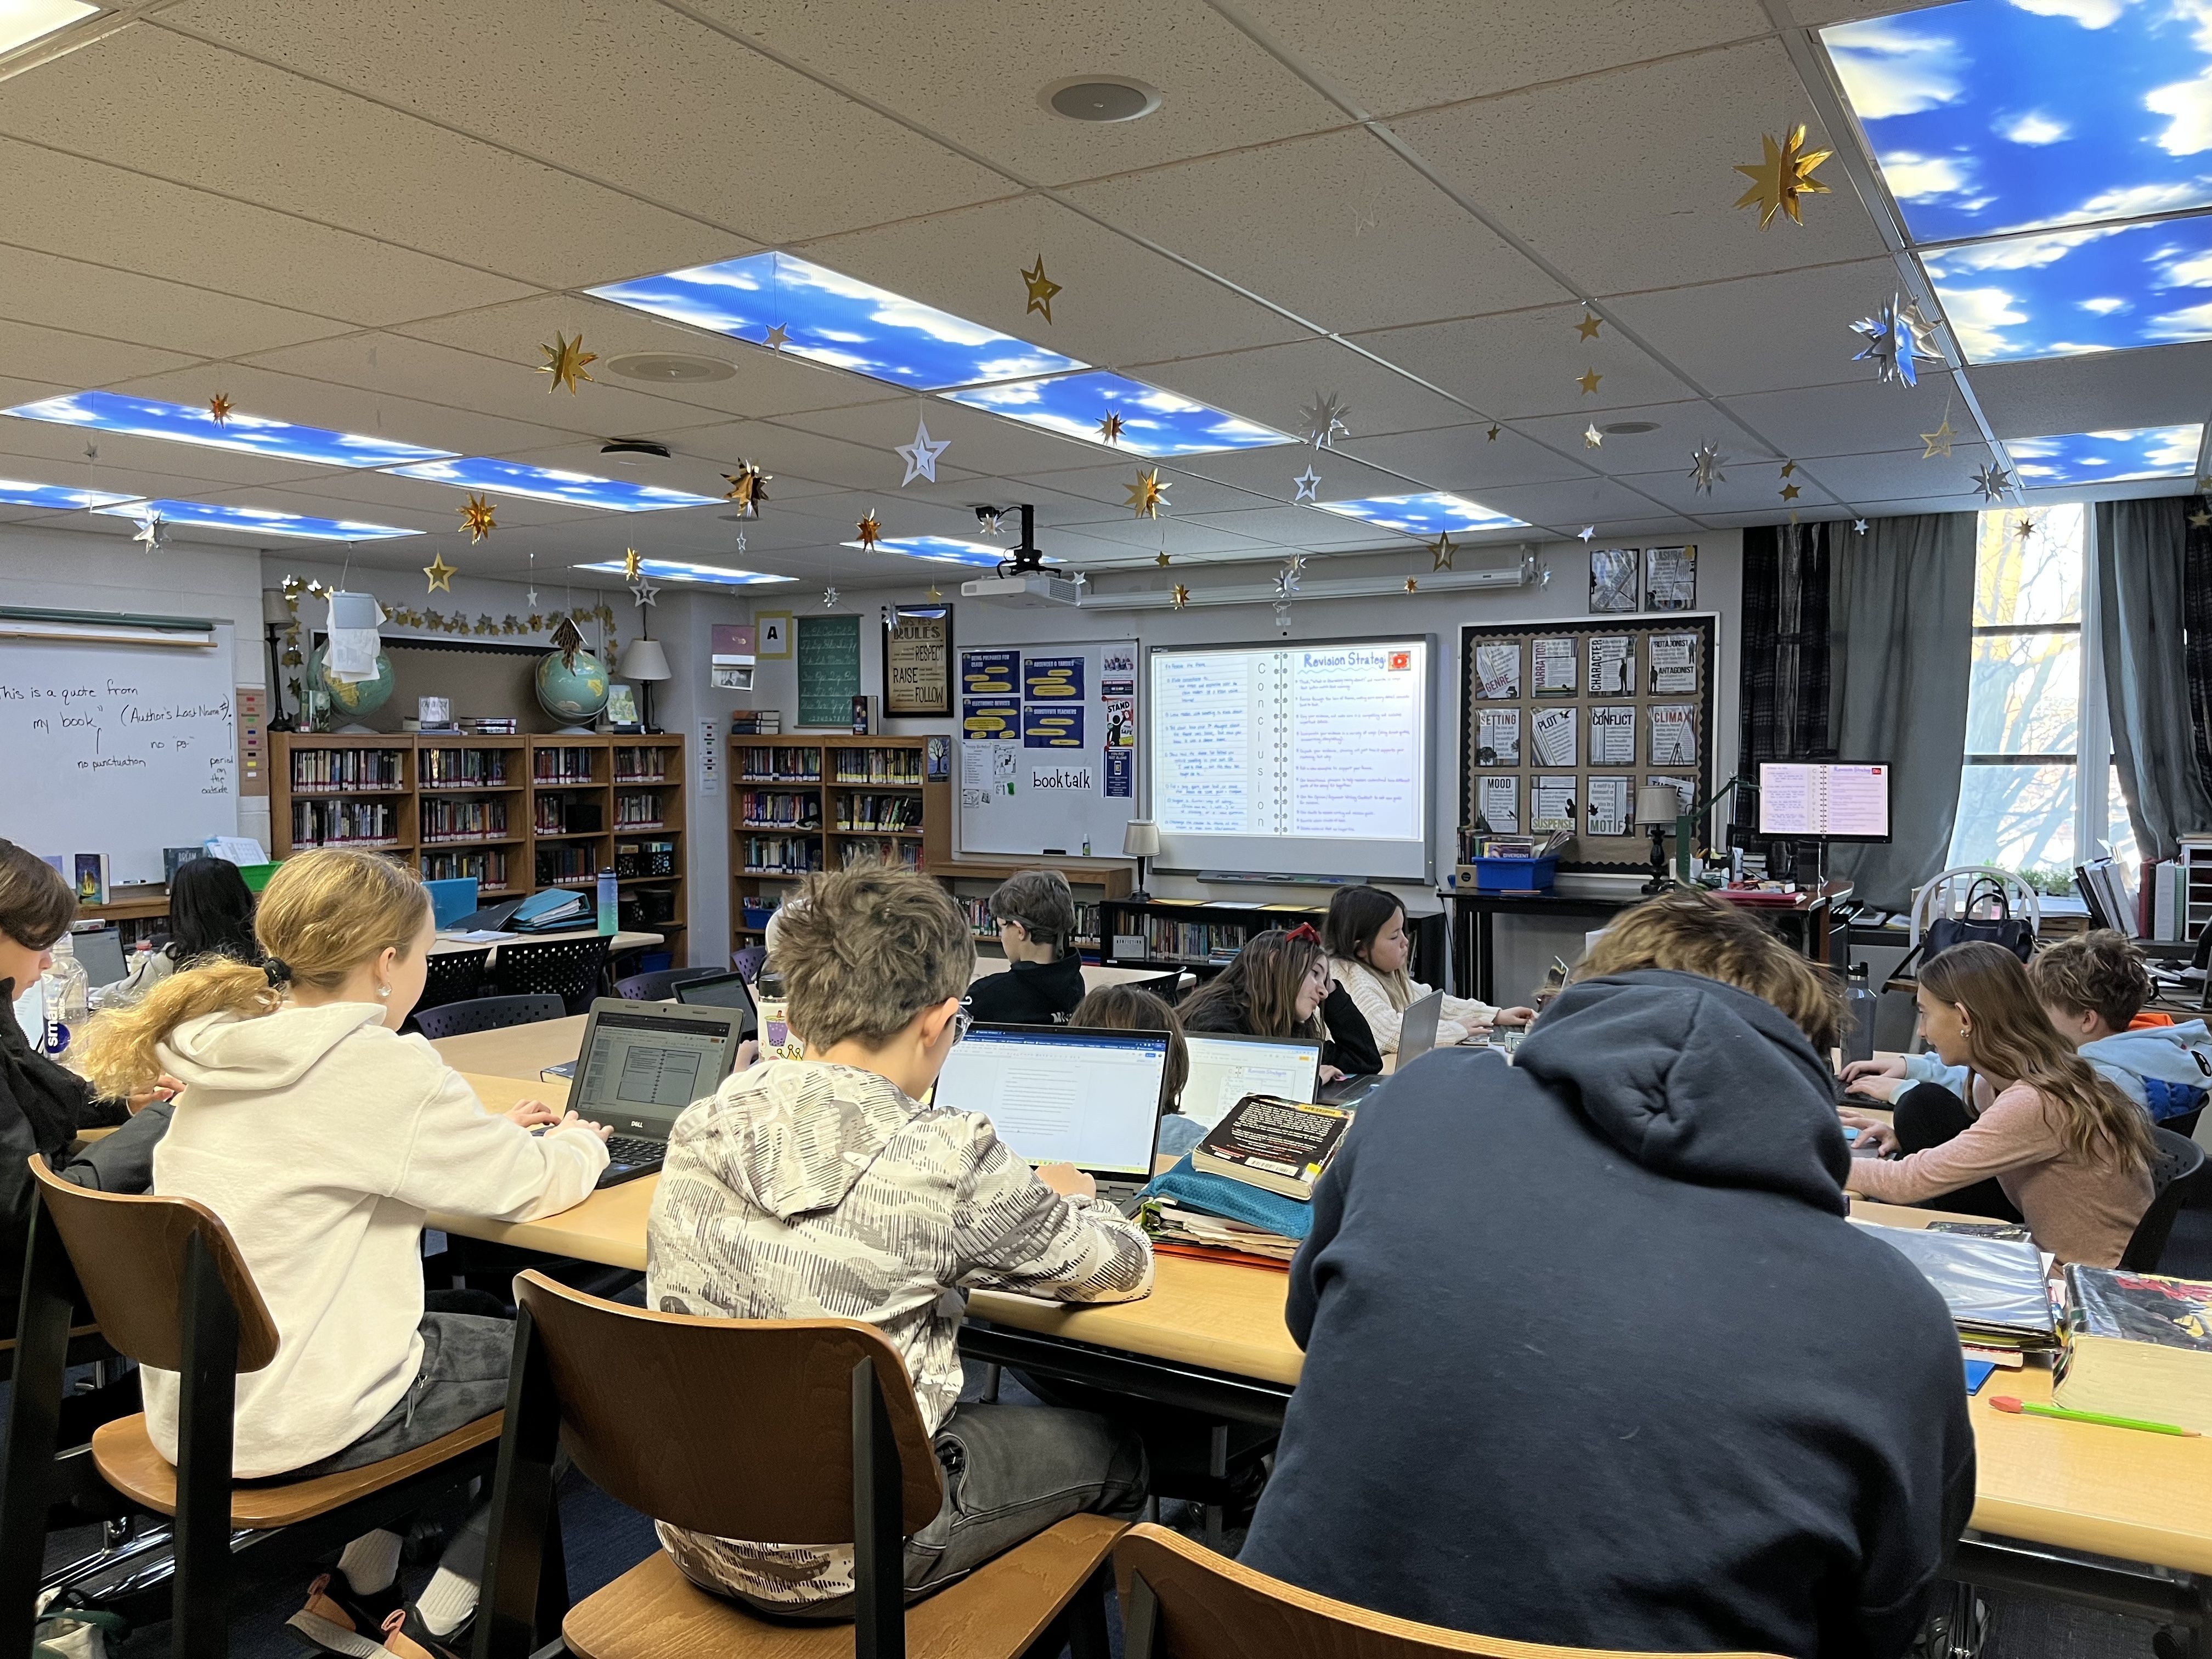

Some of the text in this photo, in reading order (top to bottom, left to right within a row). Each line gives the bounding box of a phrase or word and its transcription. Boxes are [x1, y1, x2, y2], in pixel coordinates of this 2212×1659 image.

[767, 627, 778, 639] A
[894, 627, 940, 640] RULES
[916, 645, 944, 661] RESPECT
[1304, 653, 1345, 667] Revision
[1536, 641, 1545, 687] NARRATION
[1591, 640, 1602, 691] CHARACTER
[1658, 666, 1694, 674] ANTAGONIST
[893, 668, 918, 684] RAISE
[1485, 674, 1509, 692] GENRE
[31, 687, 41, 697] is
[47, 689, 57, 698] a
[61, 688, 97, 706] quote
[107, 679, 138, 695] from
[916, 687, 943, 703] FOLLOW
[1108, 701, 1130, 713] STAND
[1480, 715, 1516, 725] SETTING
[1538, 715, 1558, 731] PLOT
[1593, 714, 1632, 725] CONFLICT
[1654, 712, 1691, 723] CLIMAX
[33, 718, 49, 734] my
[77, 755, 146, 772] no punctuation
[210, 775, 224, 785] the
[1487, 778, 1511, 788] MOOD
[1533, 818, 1573, 829] SUSPENSE
[1590, 820, 1624, 833] MOTIF
[47, 996, 58, 1047] smart
